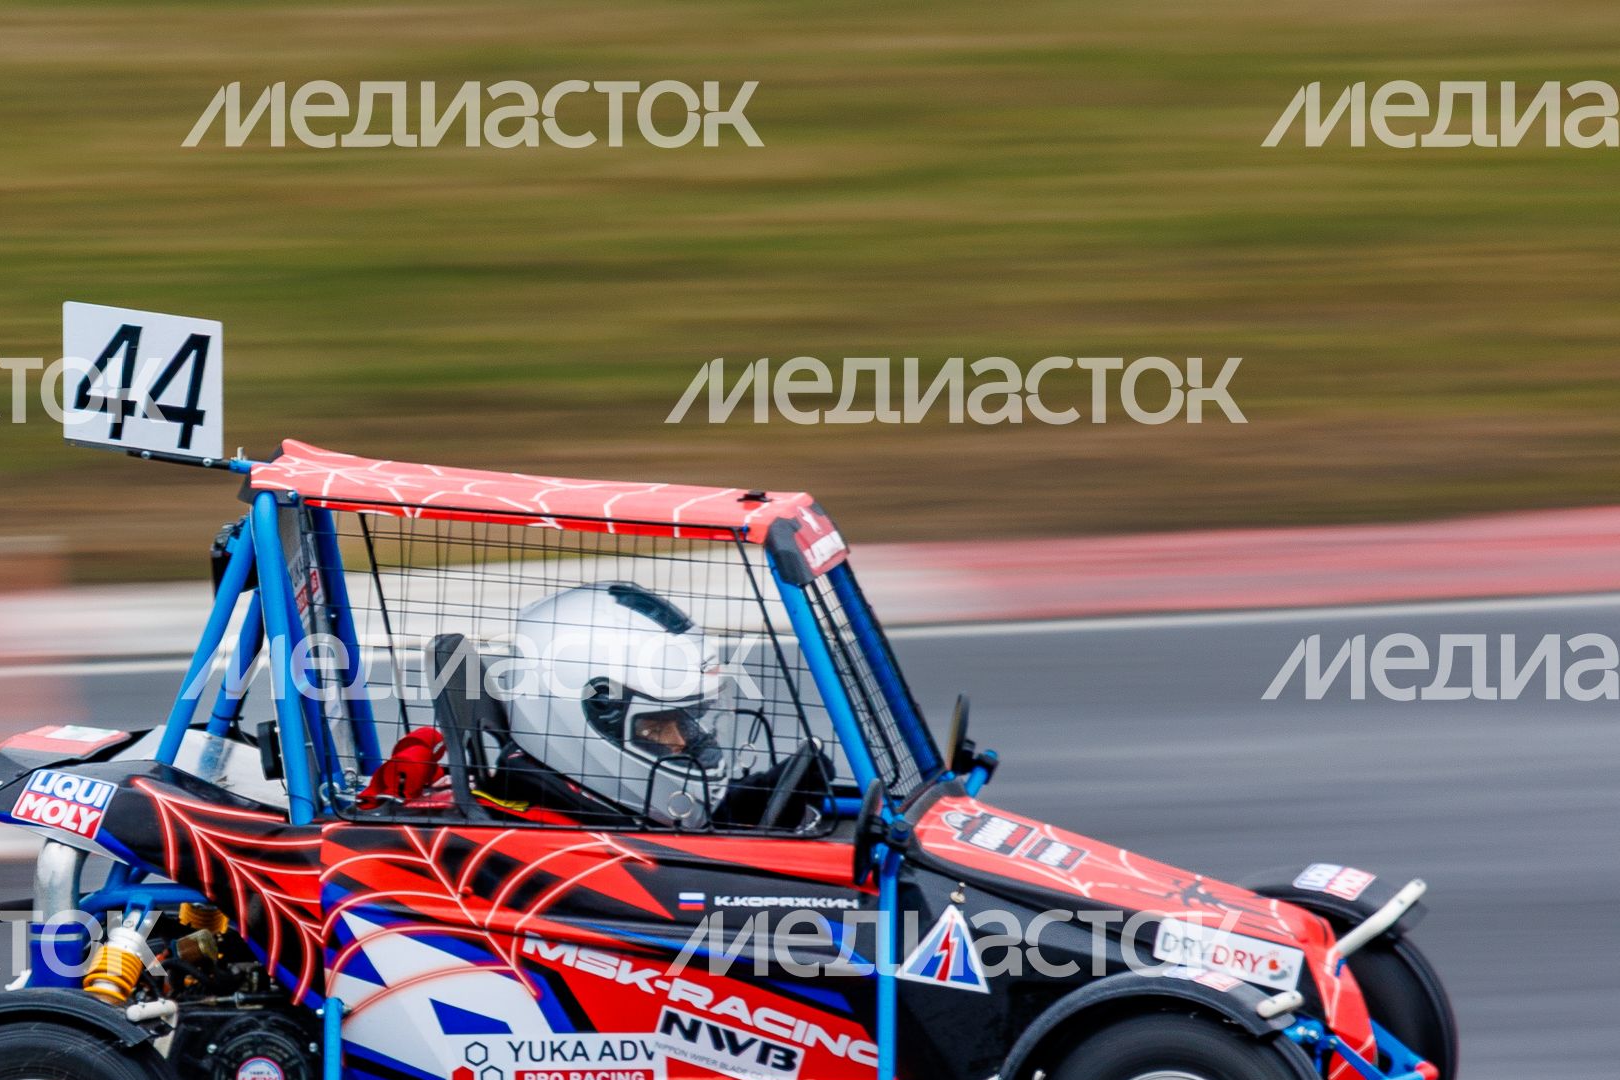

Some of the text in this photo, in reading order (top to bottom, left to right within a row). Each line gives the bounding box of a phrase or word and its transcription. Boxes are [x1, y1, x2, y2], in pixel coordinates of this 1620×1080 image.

[74, 324, 211, 449] 44
[31, 771, 111, 808] LIQUI
[17, 794, 101, 834] MOLY
[1161, 932, 1263, 973] DRYDRY
[508, 1041, 590, 1063] YUKA
[660, 1010, 798, 1071] NWB
